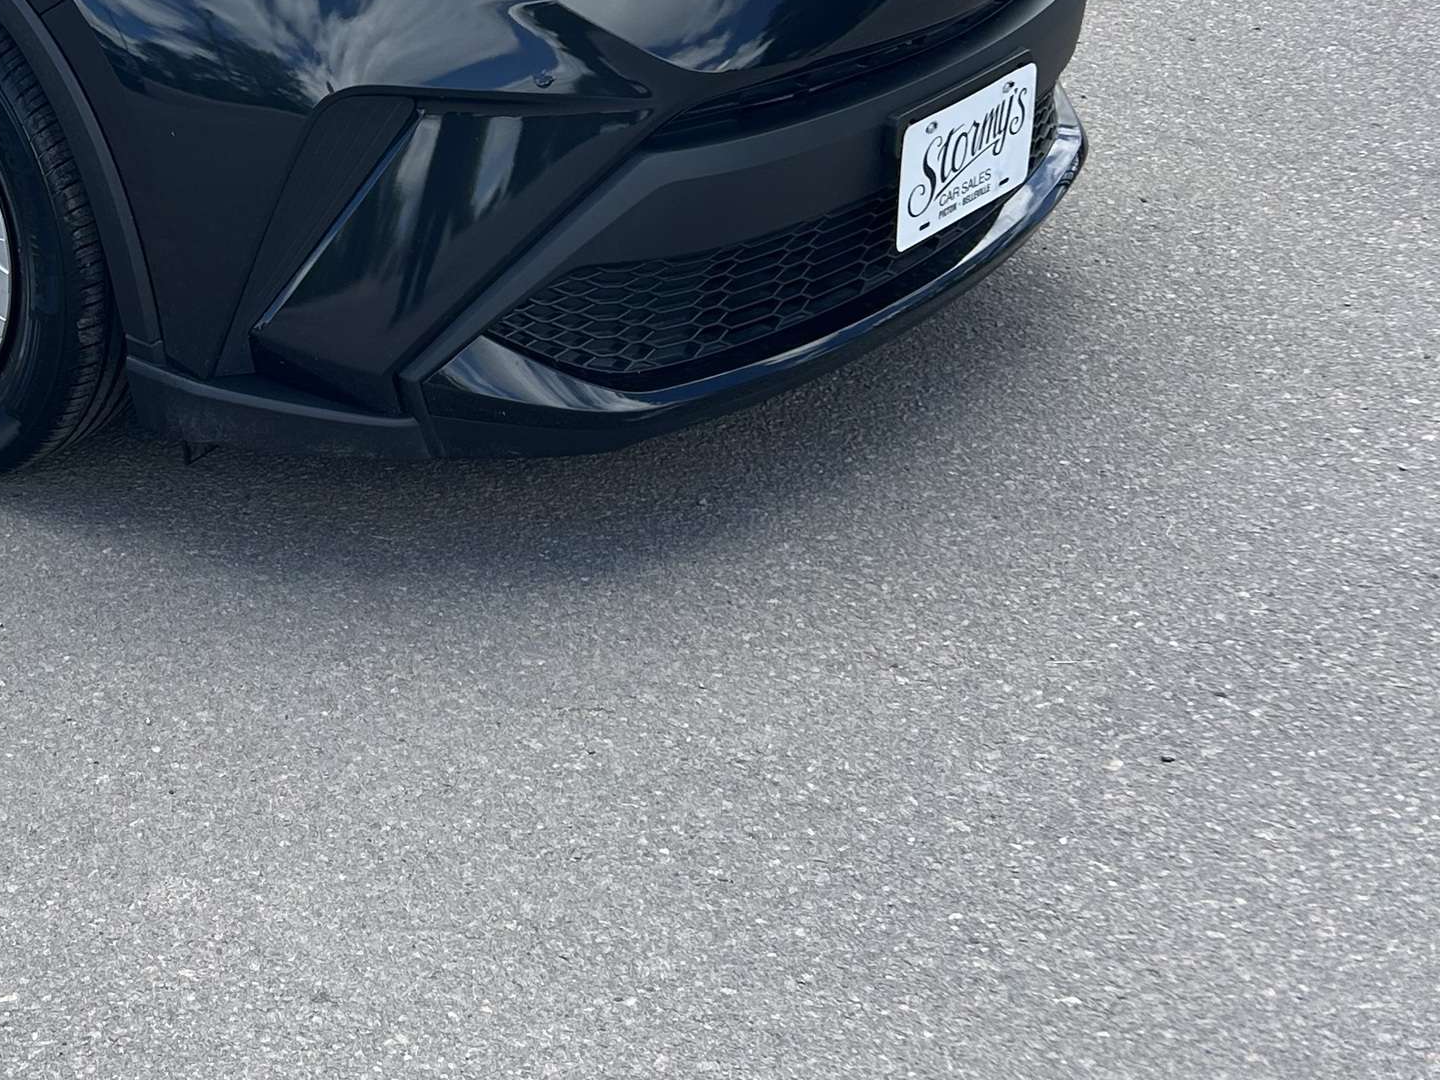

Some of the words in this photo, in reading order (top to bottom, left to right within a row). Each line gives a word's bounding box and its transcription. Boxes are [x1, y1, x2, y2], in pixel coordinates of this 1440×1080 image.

[907, 86, 1027, 218] Stormy's
[939, 186, 960, 207] CAR
[961, 168, 992, 194] SALES
